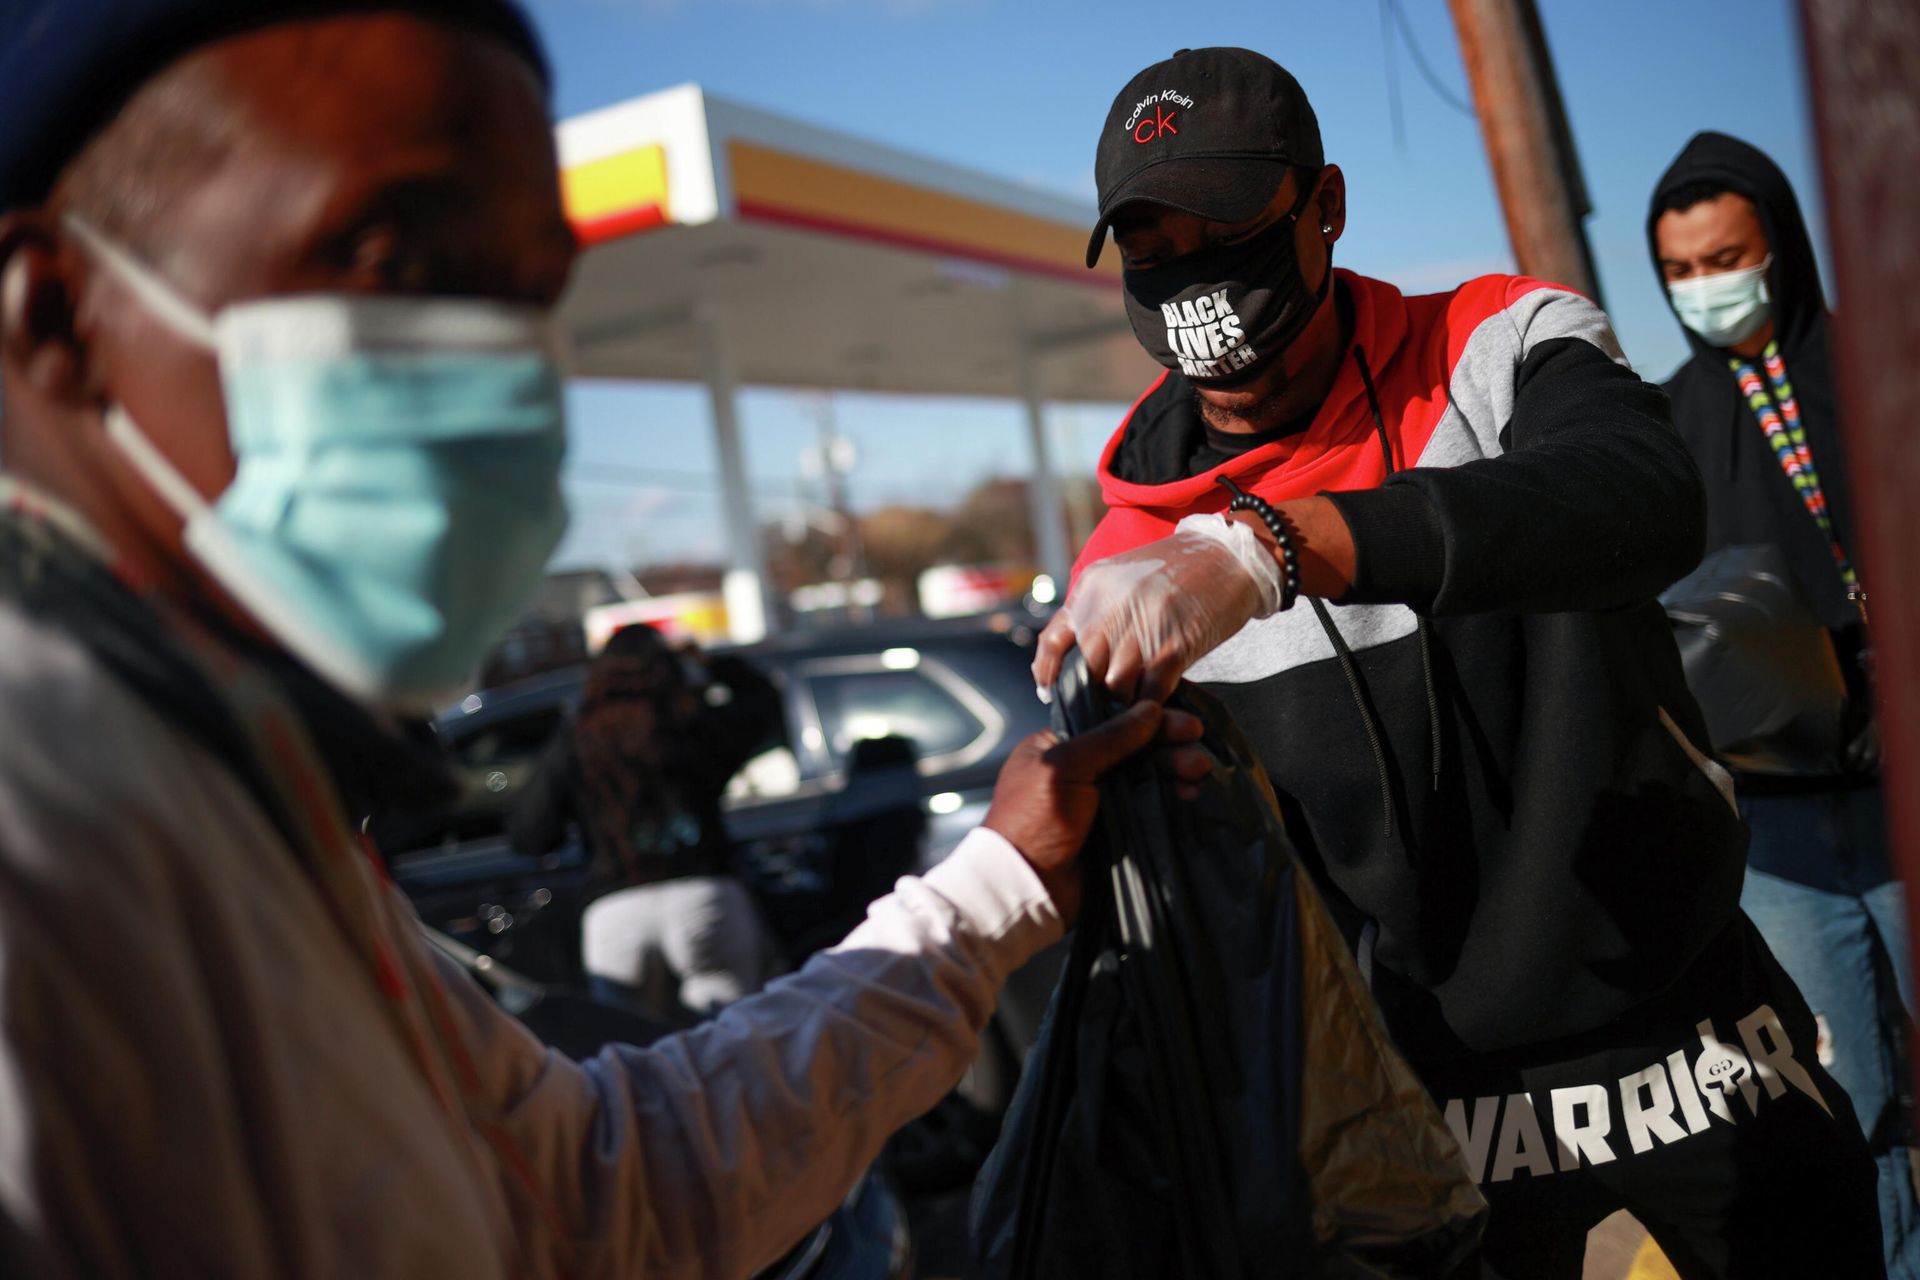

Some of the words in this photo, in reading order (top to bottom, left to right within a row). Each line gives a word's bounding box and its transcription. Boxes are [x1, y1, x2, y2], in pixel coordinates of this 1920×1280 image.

[1125, 95, 1158, 130] Calvin
[1160, 90, 1194, 109] Klein
[1159, 288, 1234, 328] BLACK
[1167, 314, 1245, 360] LIVES
[1177, 343, 1258, 377] MATTER
